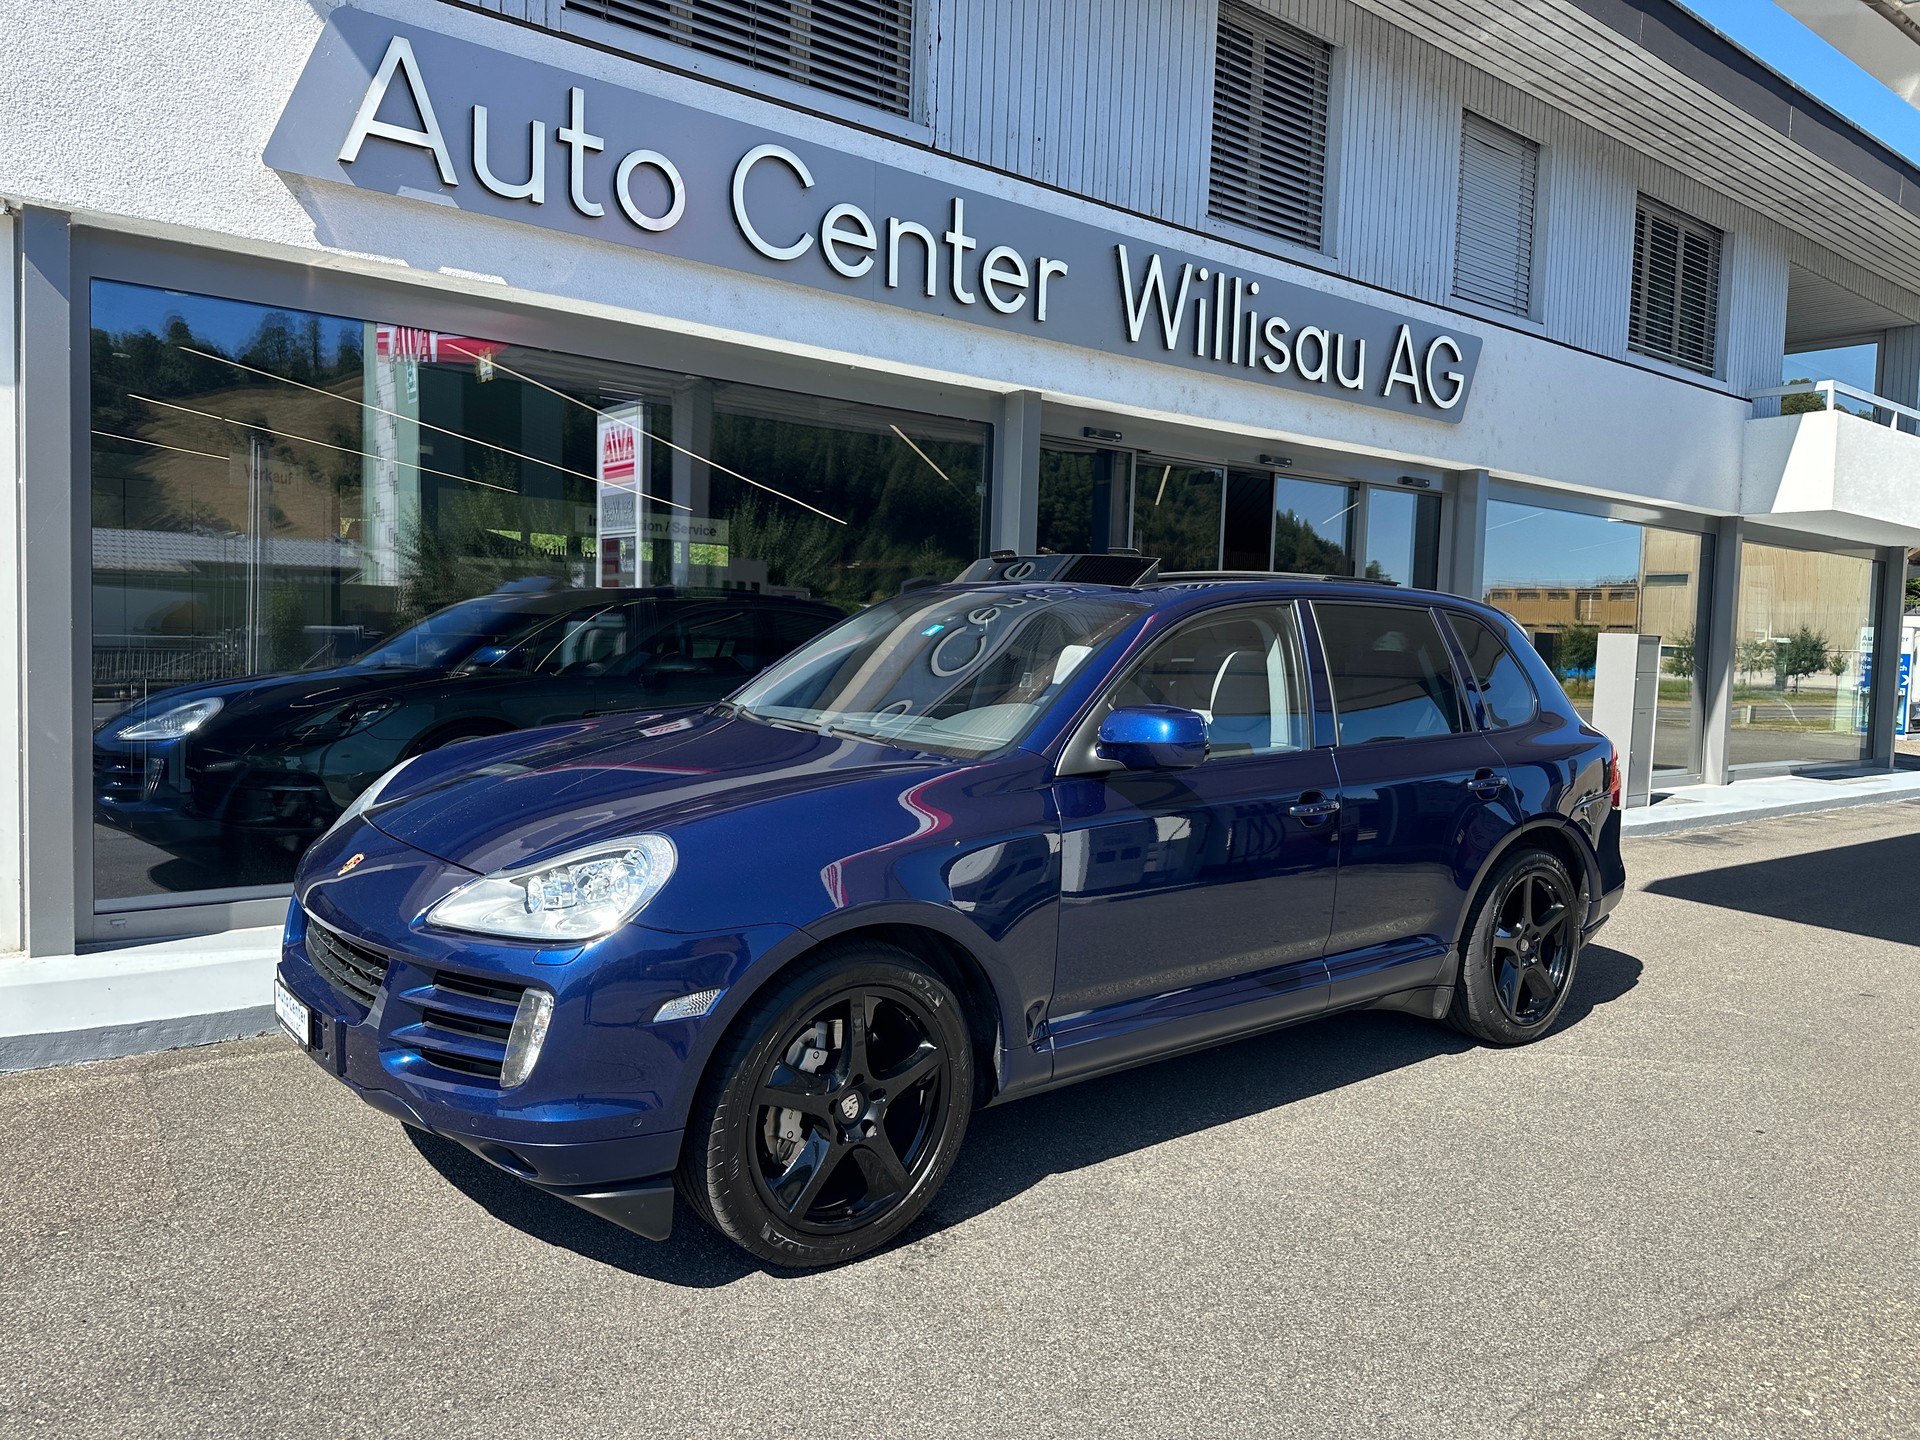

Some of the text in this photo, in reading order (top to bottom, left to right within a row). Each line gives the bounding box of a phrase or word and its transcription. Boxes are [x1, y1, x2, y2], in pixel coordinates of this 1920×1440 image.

[338, 36, 1465, 411] Auto Center Willisau AG
[588, 514, 663, 532] Inormaion
[672, 521, 717, 536] Service
